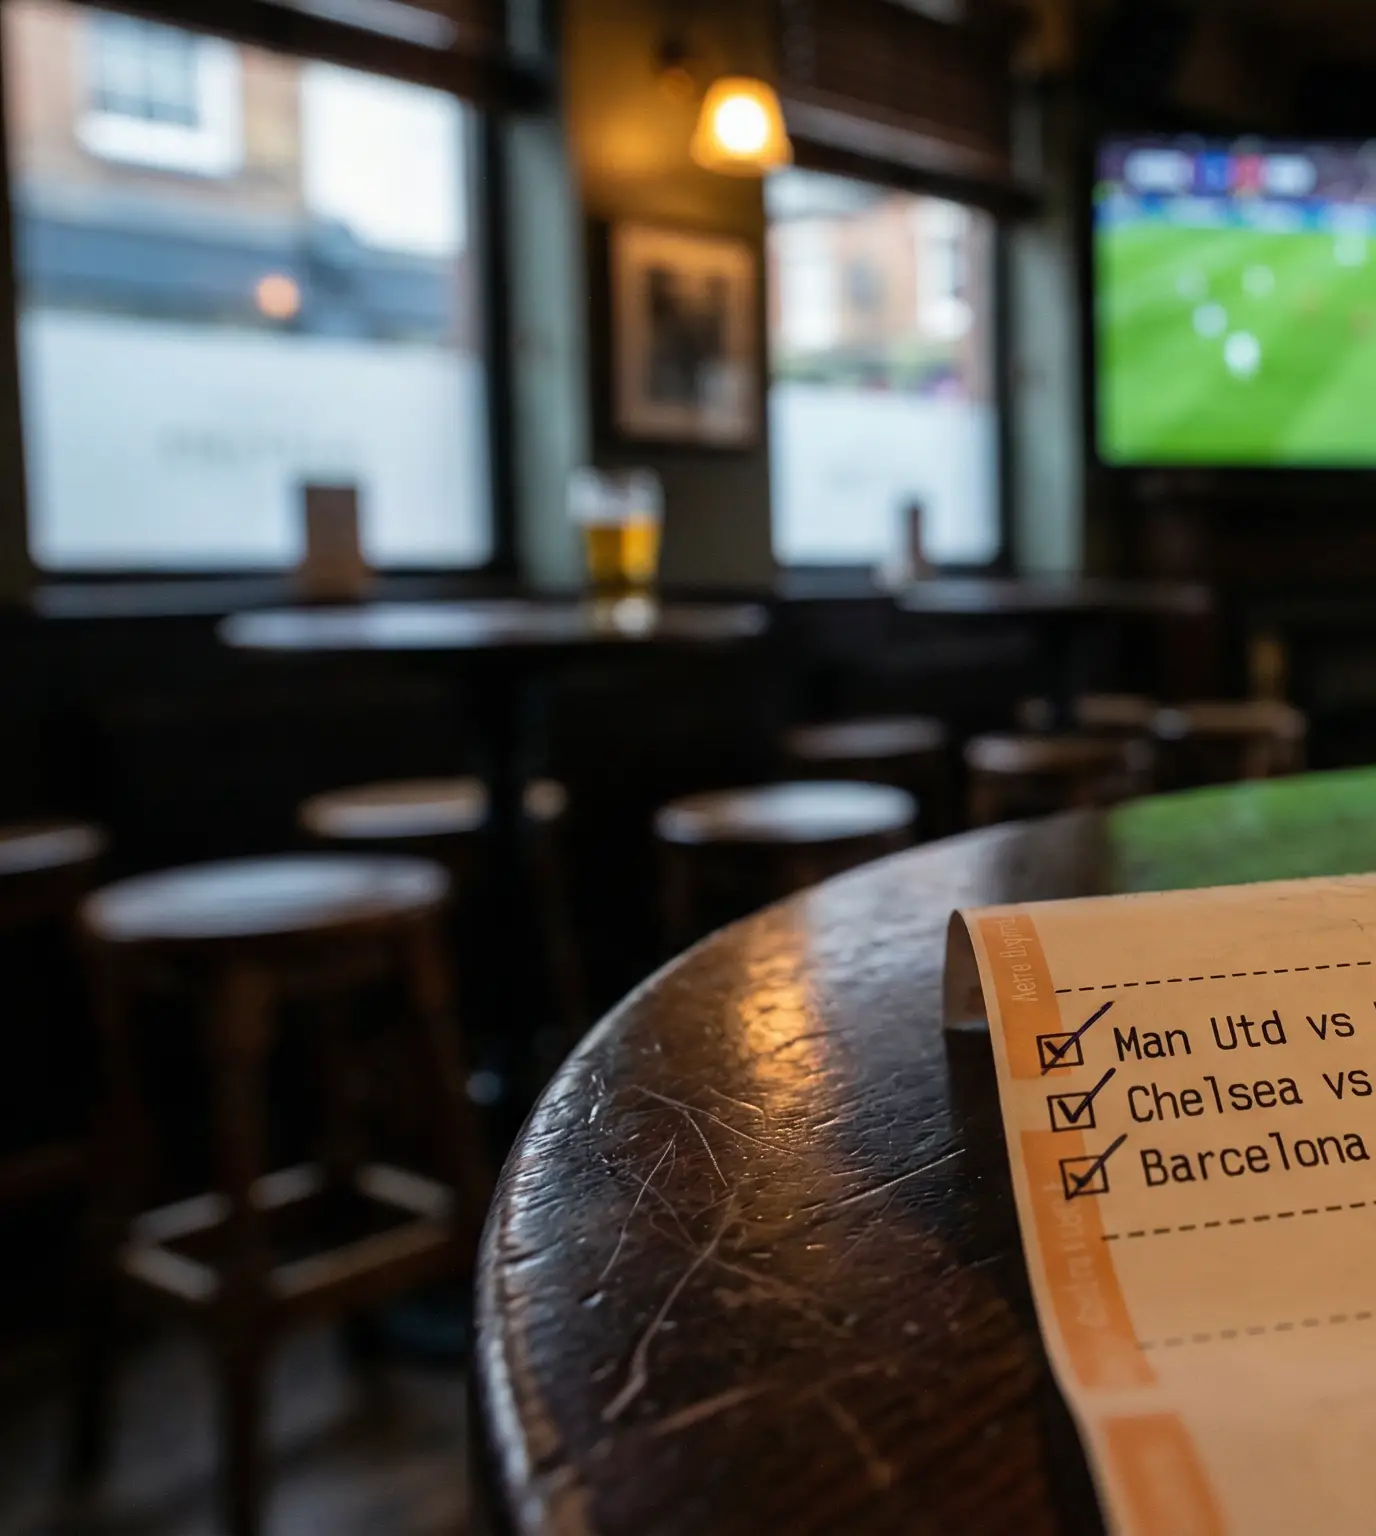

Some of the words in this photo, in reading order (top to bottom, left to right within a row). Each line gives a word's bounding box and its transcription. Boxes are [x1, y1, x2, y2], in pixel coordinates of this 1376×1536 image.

[1113, 1025, 1192, 1062] Man
[1209, 1009, 1288, 1051] Utd
[1305, 1012, 1355, 1041] vs
[1127, 1075, 1304, 1124] Chelsea
[1321, 1069, 1373, 1100] vs
[1139, 1131, 1371, 1188] Barcelona
